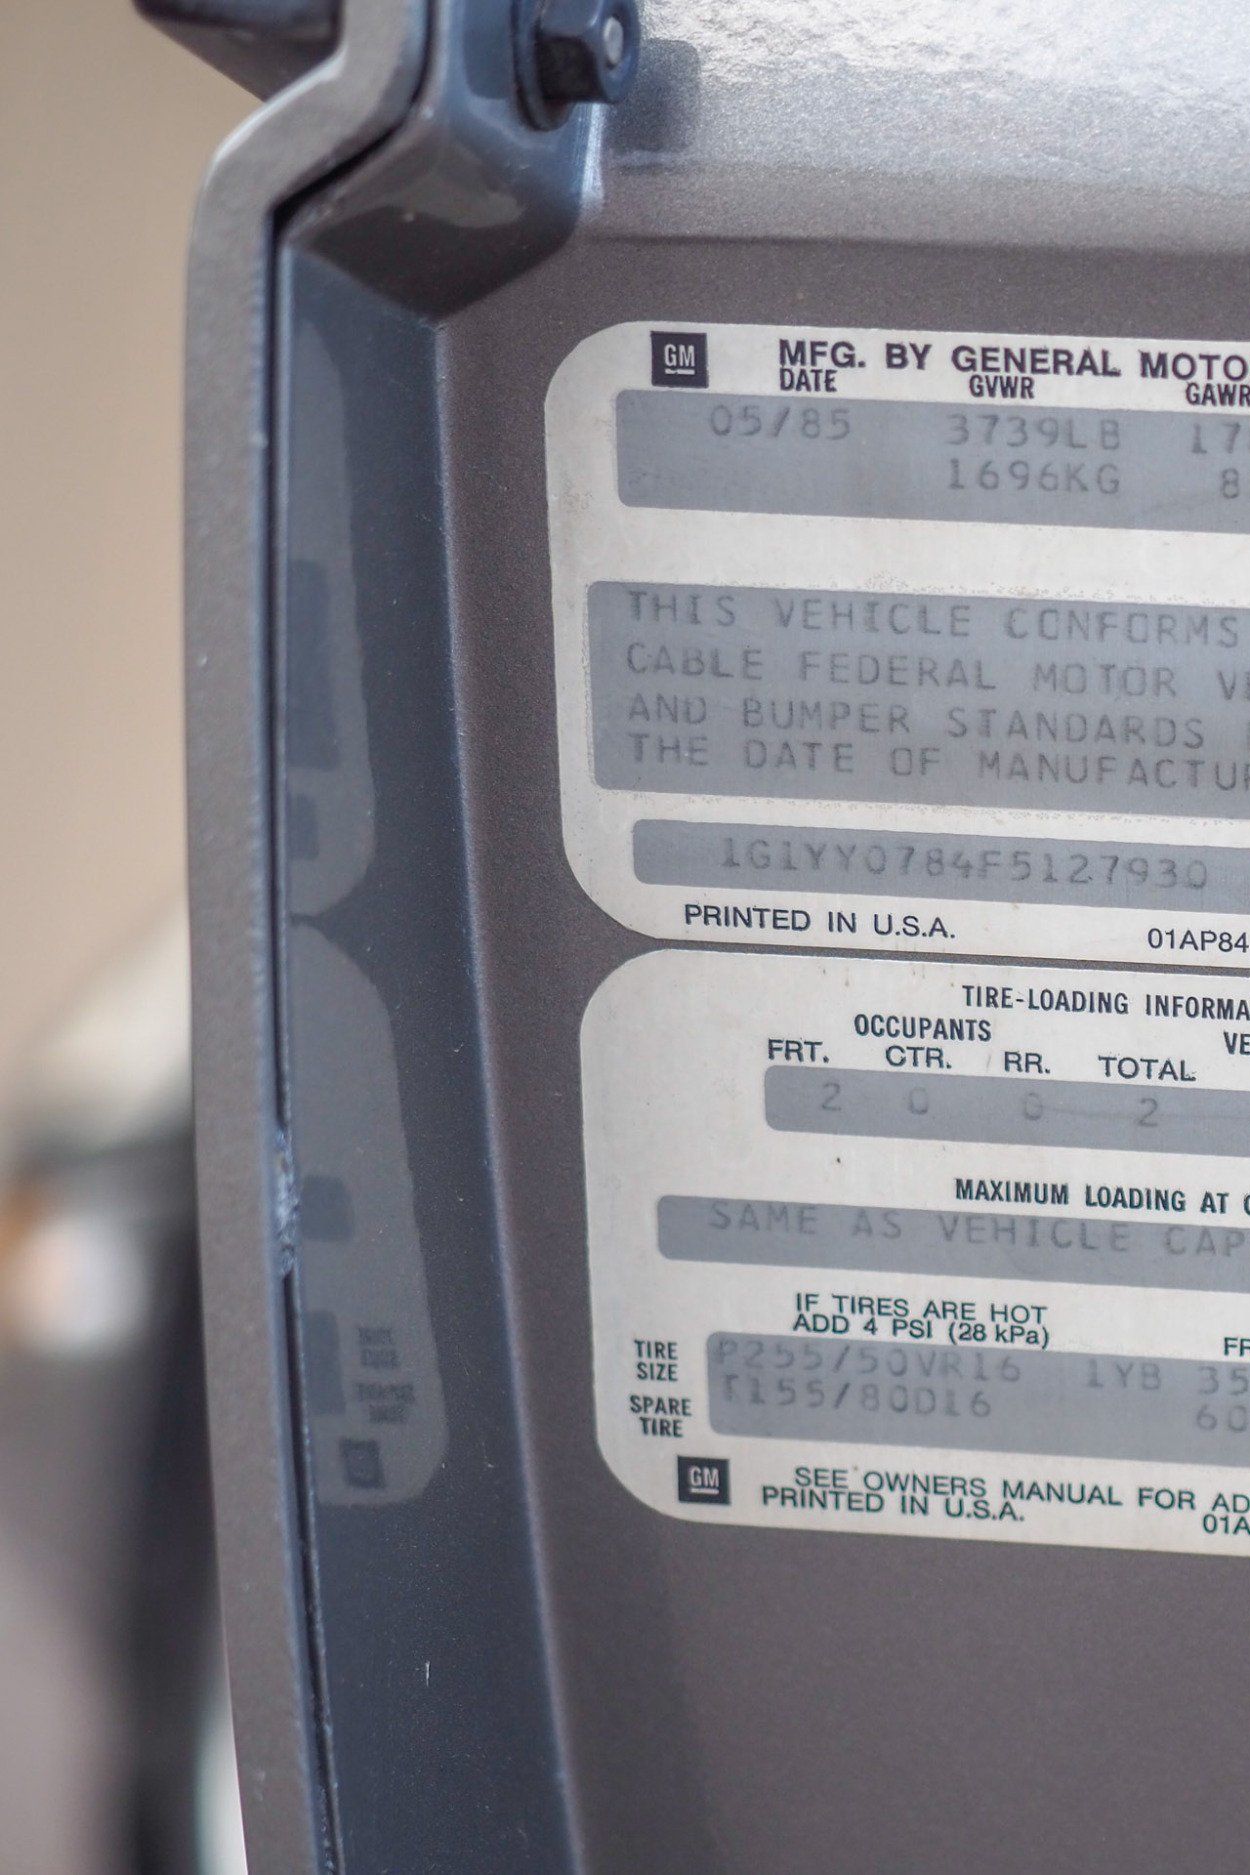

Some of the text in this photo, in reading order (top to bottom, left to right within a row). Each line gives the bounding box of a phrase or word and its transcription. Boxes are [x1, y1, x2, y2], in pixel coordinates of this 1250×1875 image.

[664, 344, 696, 375] GM
[779, 339, 865, 368] MFG.
[886, 343, 933, 371] BY
[951, 346, 1121, 378] GENERAL
[779, 368, 838, 393] DATE
[969, 375, 1035, 399] GVWR
[709, 405, 852, 440] 05/85
[946, 414, 1121, 450] 3739LB
[948, 459, 1120, 495] 1696KG
[628, 591, 736, 627] THIS
[773, 600, 972, 637] VEHICLE
[1004, 607, 1239, 648] CONFORMS
[626, 642, 763, 681] CABLE
[799, 652, 997, 690] FEDERAL
[1033, 665, 1177, 698] MOTOR
[627, 694, 707, 726] AND
[742, 699, 911, 735] BUMPER
[948, 708, 1205, 750] STANDARDS
[628, 733, 708, 765] THE
[744, 739, 854, 773] DATE
[889, 747, 942, 776] OF
[684, 904, 956, 939] PRINTED IN U.S.A.
[1147, 929, 1249, 954] 01AP84
[962, 985, 1128, 1015] TIRE-LOADING
[854, 1014, 992, 1042] OCCUPANTS
[768, 1039, 830, 1064] FRT.
[885, 1046, 952, 1069] CTR.
[1003, 1052, 1050, 1075] RR.
[1099, 1056, 1197, 1082] TOTAL
[821, 1083, 842, 1112] 2
[907, 1086, 929, 1116] 0
[1137, 1098, 1159, 1128] 2
[955, 1178, 1069, 1206] MAXIMUM
[1085, 1185, 1186, 1212] LOADING
[1200, 1192, 1229, 1215] AT
[708, 1203, 820, 1235] SAME
[852, 1210, 901, 1240] AS
[937, 1216, 1128, 1253] VEHICLE
[796, 1293, 1048, 1325] IF TIRES ARE HOT
[793, 1313, 1050, 1350] ADD 4 PSI (28 kPa)
[634, 1339, 678, 1360] TIRE
[636, 1362, 678, 1383] SIZE
[1086, 1361, 1162, 1391] 1YB
[630, 1395, 692, 1417] SPARE
[640, 1418, 683, 1438] TIRE
[689, 1467, 719, 1494] GM
[794, 1467, 848, 1489] SEE
[864, 1471, 987, 1498] OWNERS
[1002, 1480, 1123, 1508] MANUAL
[1138, 1488, 1195, 1510] FOR
[762, 1487, 1025, 1522] PRINTED IN U.S.A.
